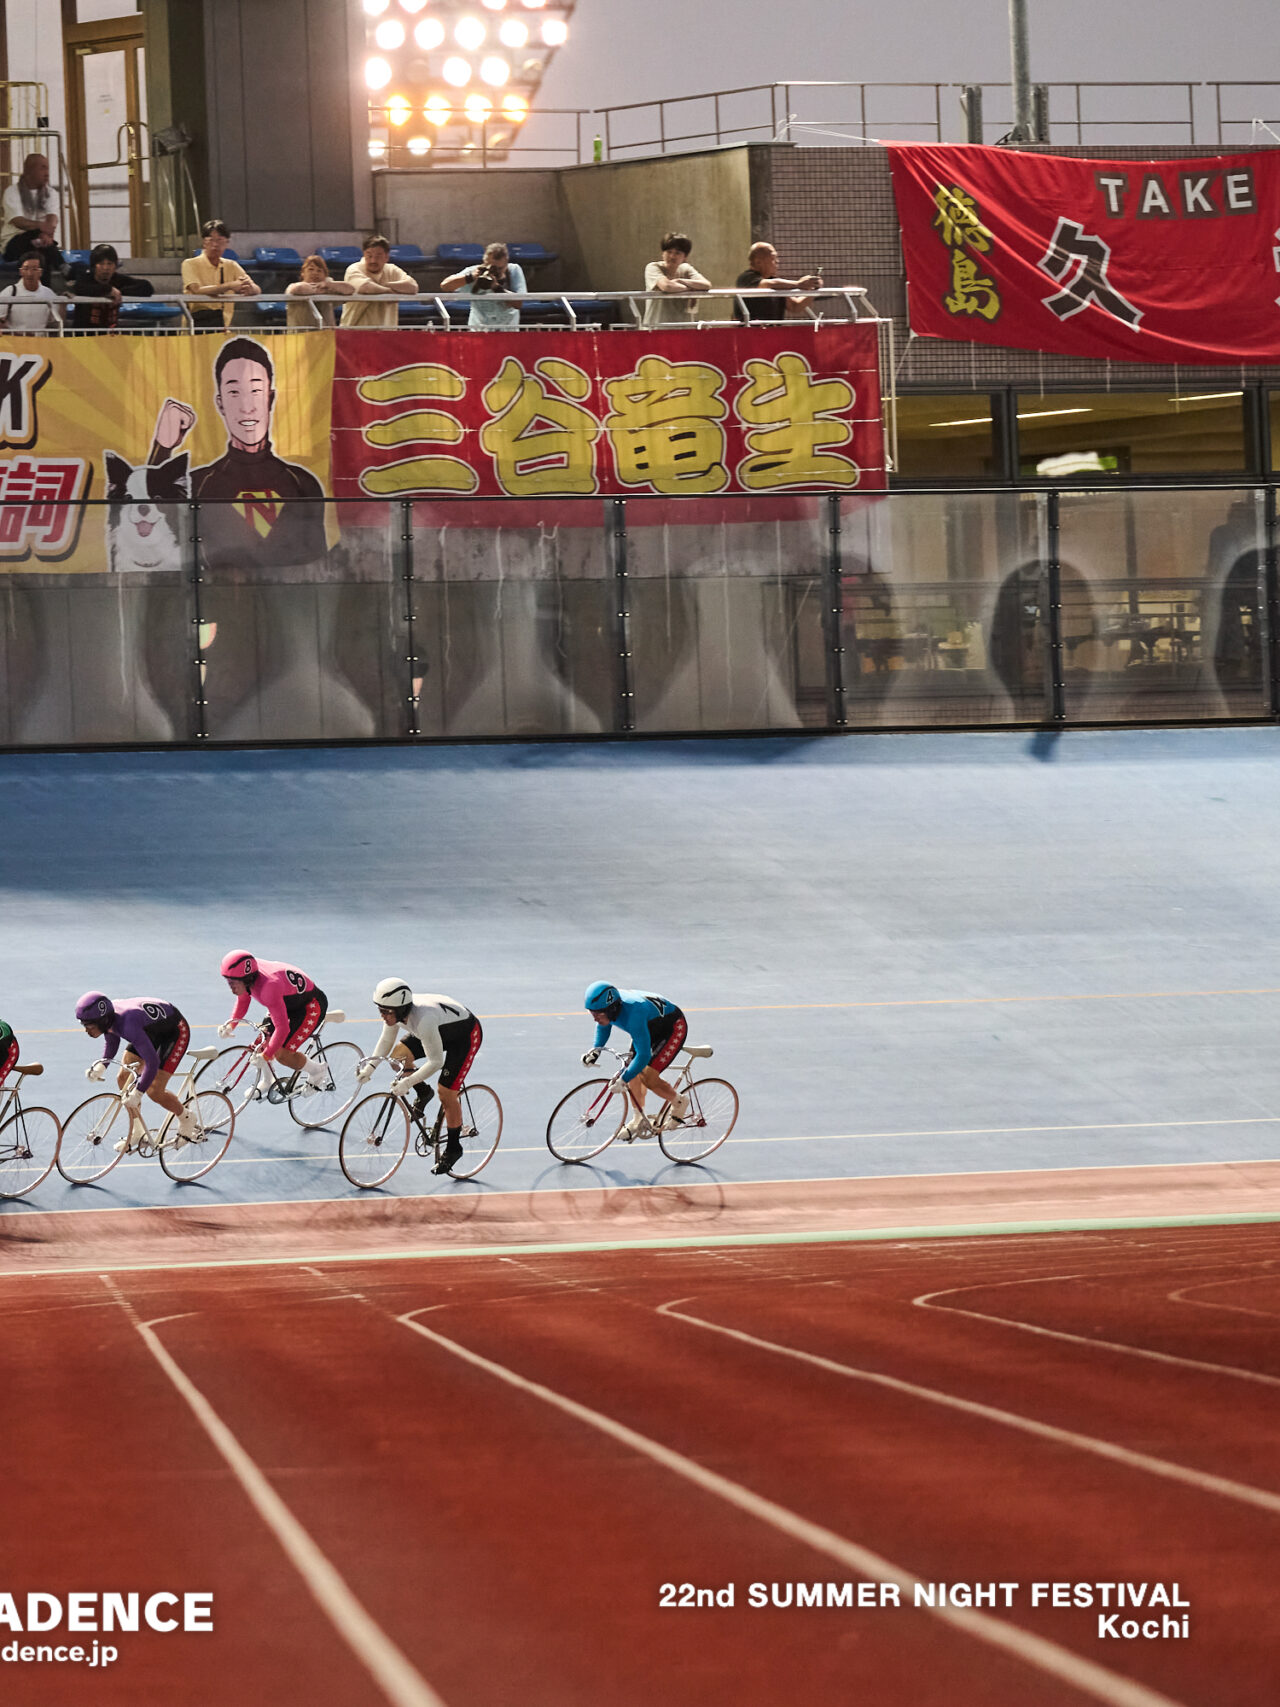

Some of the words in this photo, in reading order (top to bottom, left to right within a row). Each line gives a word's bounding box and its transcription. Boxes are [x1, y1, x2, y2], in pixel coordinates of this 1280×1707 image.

[1098, 172, 1254, 215] TAKE
[933, 181, 1000, 321] 徳島
[356, 351, 860, 496] 三谷竜生
[239, 488, 278, 530] N
[244, 958, 253, 975] 8
[284, 968, 307, 995] 8
[400, 989, 407, 1005] 1
[605, 988, 617, 1005] 4
[644, 994, 669, 1018] 4
[97, 1000, 108, 1017] 9
[141, 1001, 168, 1021] 9
[437, 1002, 461, 1017] 1
